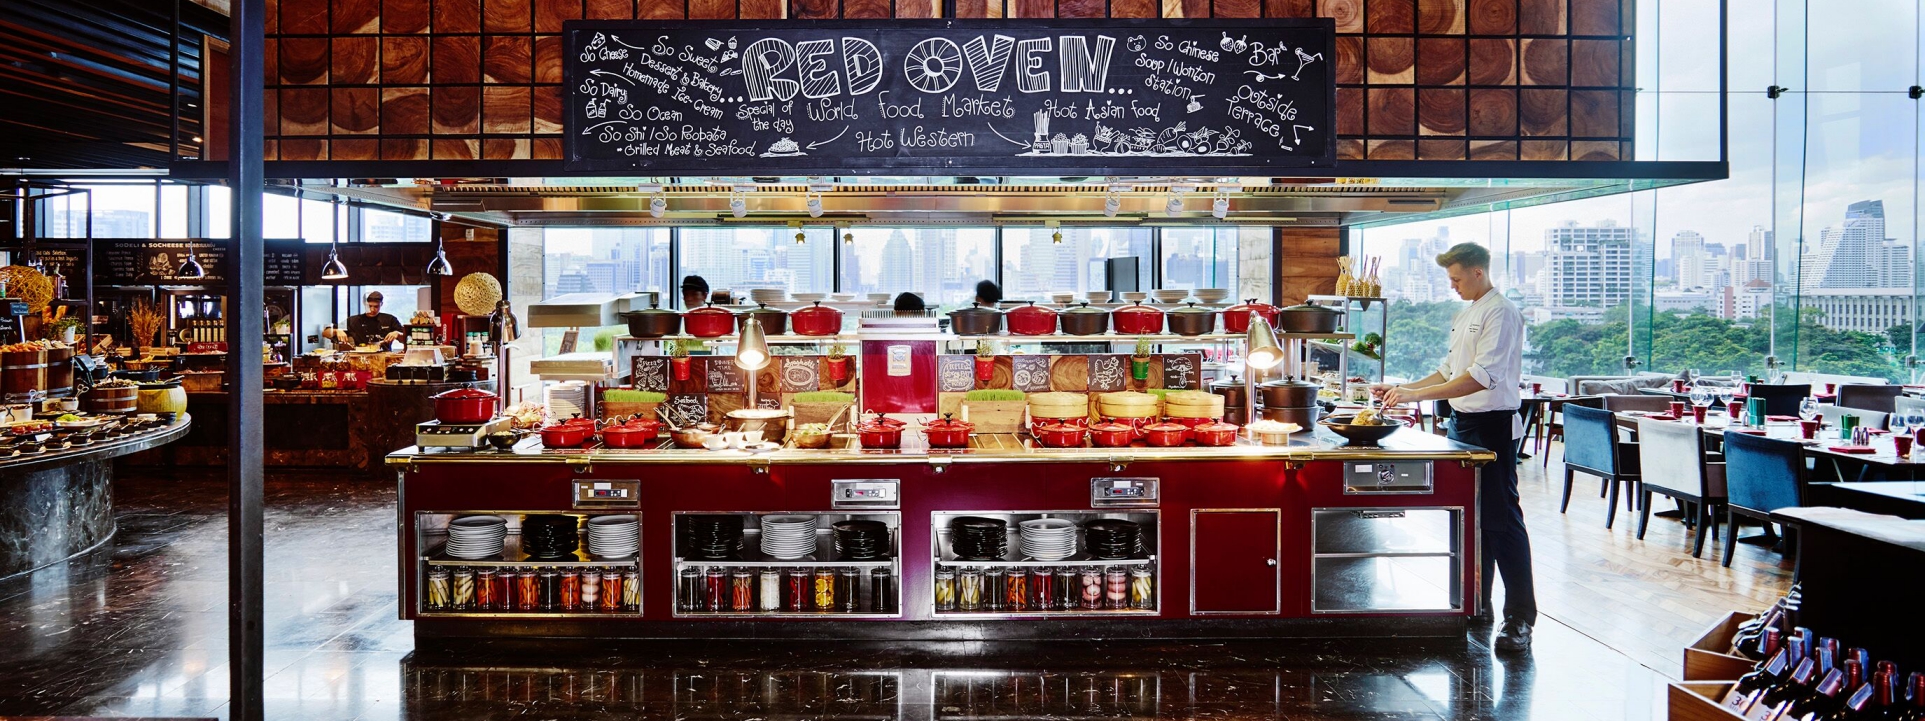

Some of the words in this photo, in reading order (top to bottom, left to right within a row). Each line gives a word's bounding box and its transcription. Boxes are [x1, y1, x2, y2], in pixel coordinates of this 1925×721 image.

[579, 45, 596, 63] So
[599, 46, 629, 61] Cheese
[652, 35, 675, 55] So
[679, 45, 718, 73] Sweet
[1154, 35, 1174, 51] So
[1178, 40, 1219, 62] Chinese
[1248, 42, 1281, 66] Bar
[1135, 53, 1165, 75] Soup
[622, 62, 670, 94] Homemade
[641, 53, 683, 80] Dessert
[680, 72, 690, 86] &
[690, 72, 722, 102] Bakery
[1144, 73, 1192, 100] Station
[579, 78, 598, 96] So
[600, 82, 628, 105] Dairy
[1237, 85, 1297, 120] Outside
[618, 104, 642, 120] So
[646, 106, 683, 121] Ocean
[736, 101, 775, 120] Special
[782, 101, 794, 115] of
[806, 98, 858, 122] World
[941, 93, 1016, 119] Market
[1044, 98, 1078, 119] Hot
[1085, 98, 1125, 120] Asian
[1225, 95, 1280, 137] Terrace
[598, 125, 622, 143] So
[625, 126, 647, 141] Shi
[681, 124, 727, 143] Robata
[751, 118, 770, 132] the
[773, 118, 795, 133] day
[624, 143, 660, 157] Grilled
[664, 143, 691, 157] Meat
[694, 145, 703, 157] &
[704, 138, 757, 157] Seafood
[855, 130, 894, 153] Hot
[900, 125, 976, 148] Western
[674, 395, 699, 404] Seafood
